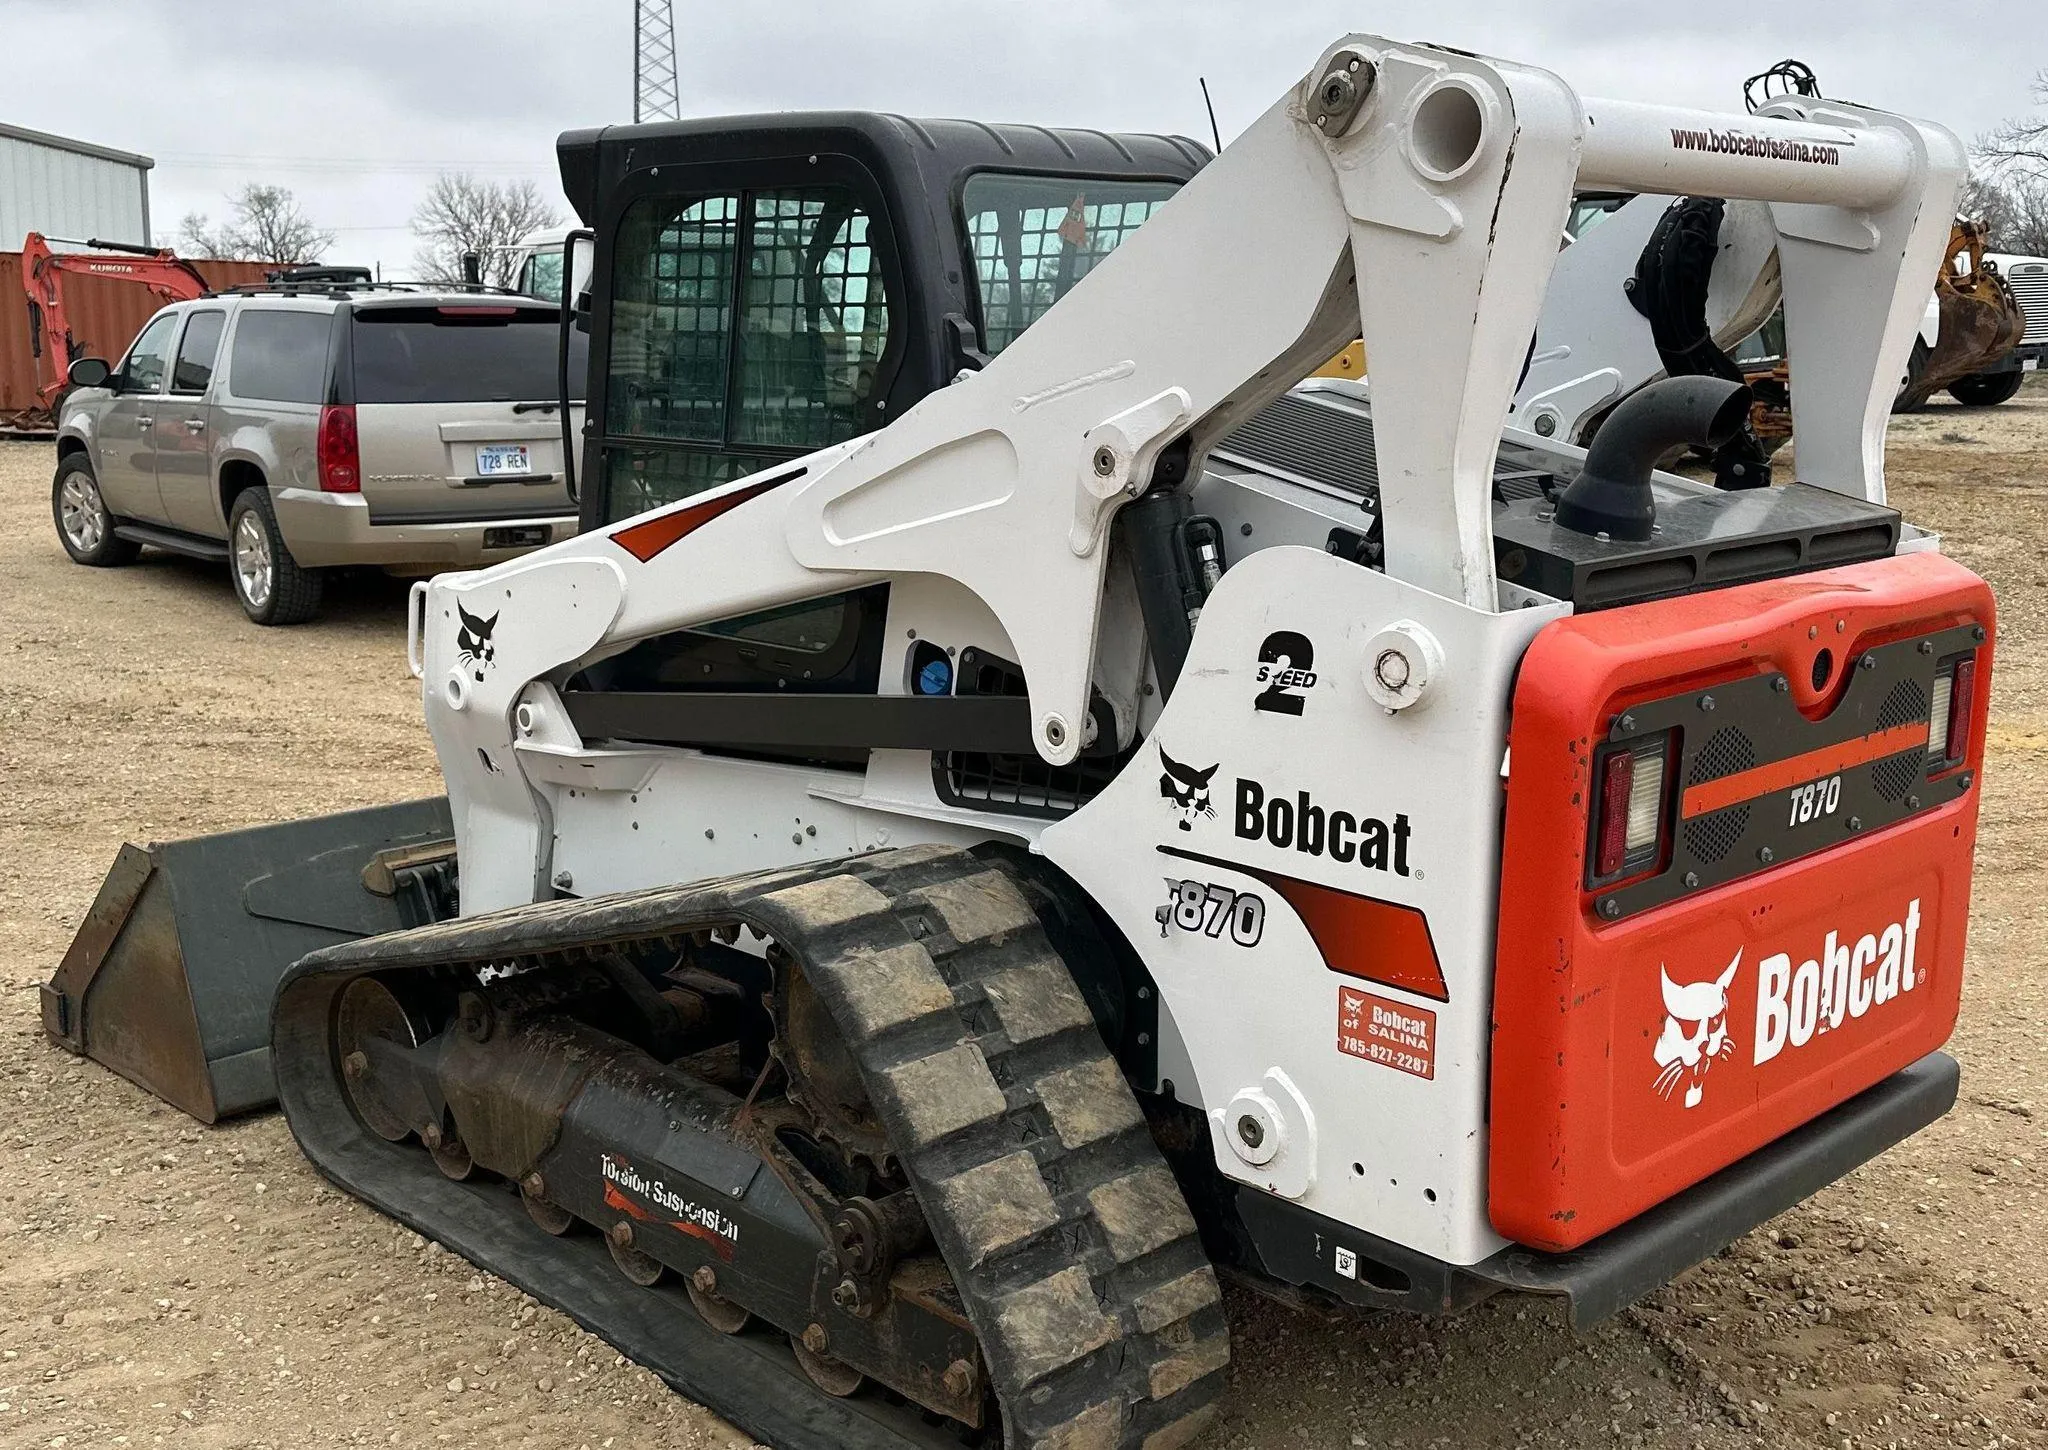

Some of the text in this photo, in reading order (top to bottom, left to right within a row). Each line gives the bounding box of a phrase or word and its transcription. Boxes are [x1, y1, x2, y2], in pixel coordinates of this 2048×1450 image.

[90, 263, 133, 273] KUBOTA
[481, 454, 528, 469] 728 REN
[1254, 631, 1314, 716] 2
[1789, 775, 1841, 827] T870
[1235, 777, 1411, 877] Bobcat
[1753, 897, 1920, 1067] Bobcat
[1343, 1019, 1428, 1052] of SALINA
[1372, 1005, 1426, 1037] Bobcat
[1343, 1035, 1428, 1074] 785-827-2287
